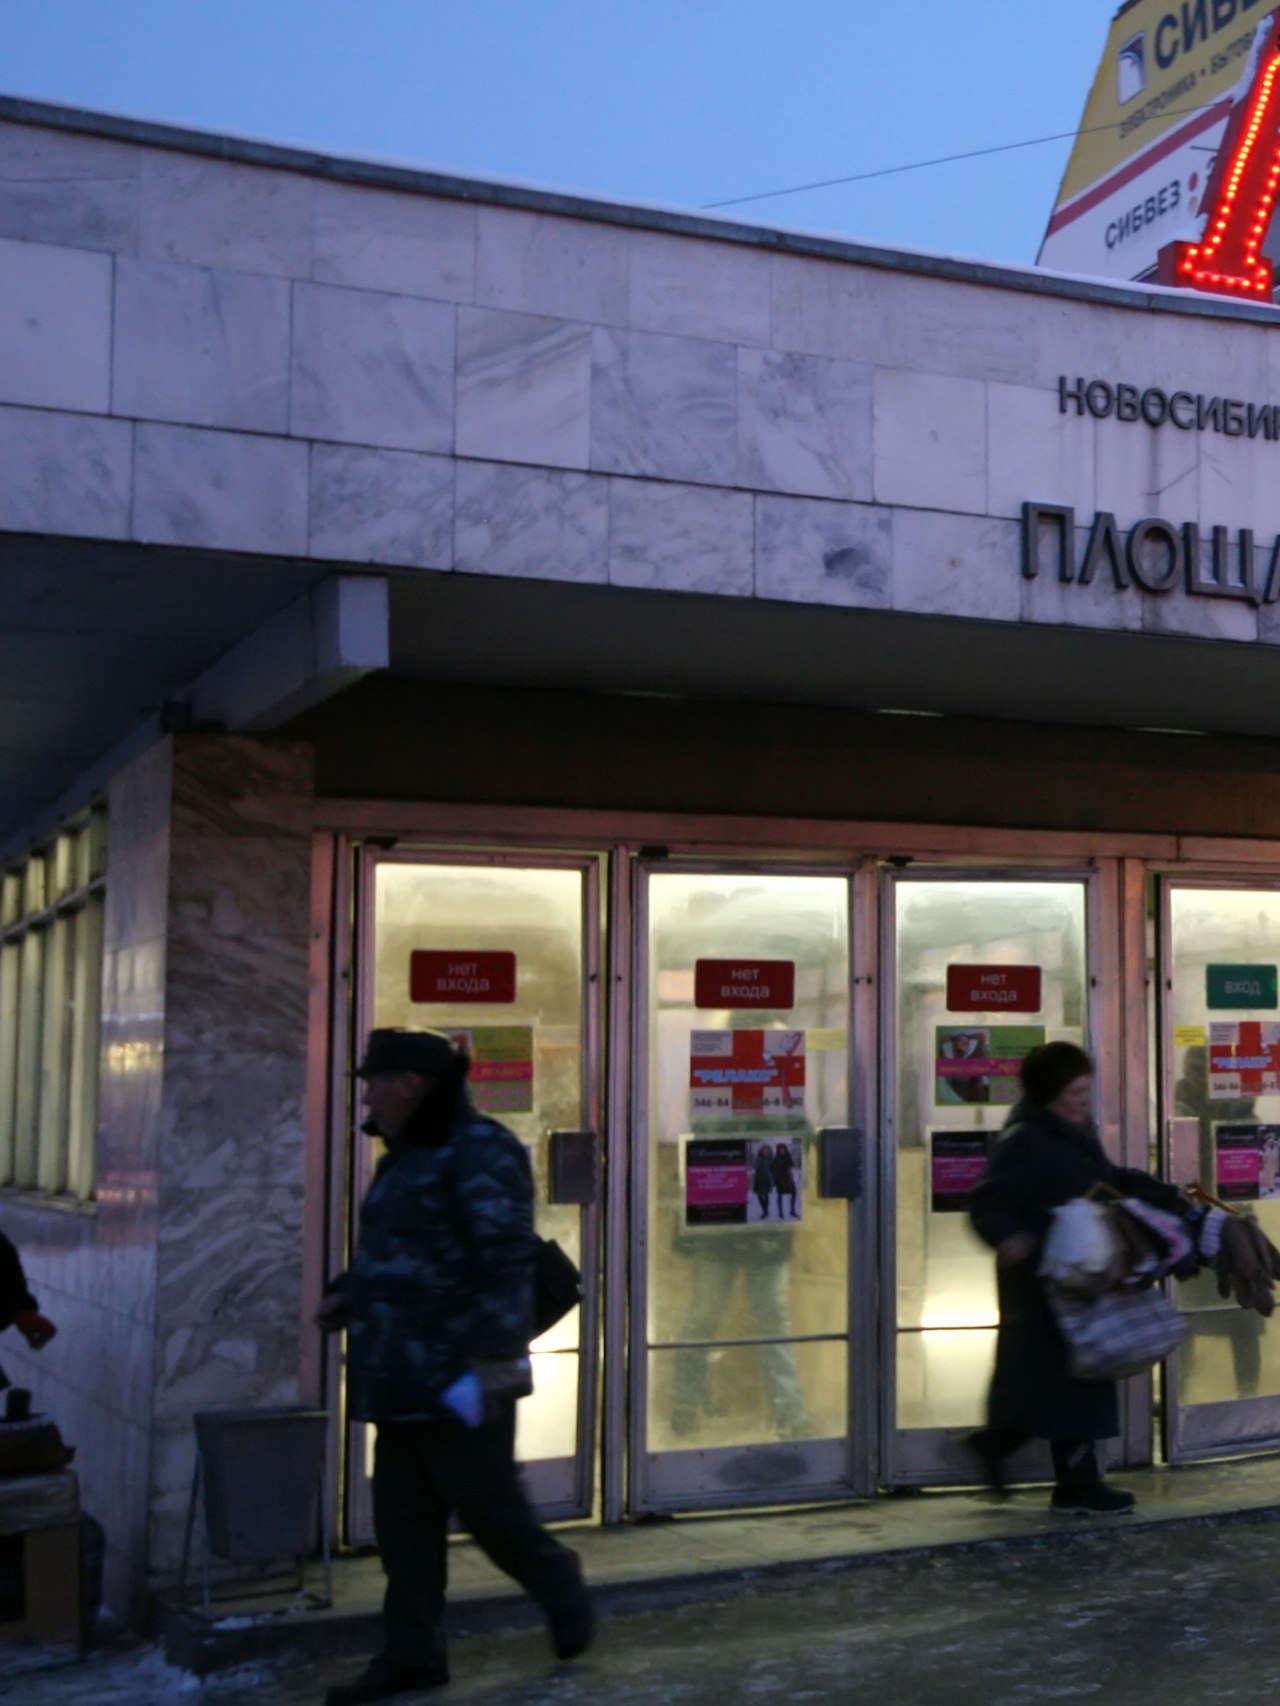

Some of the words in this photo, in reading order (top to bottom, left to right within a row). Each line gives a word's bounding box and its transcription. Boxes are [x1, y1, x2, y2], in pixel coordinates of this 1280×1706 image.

[1105, 179, 1181, 249] СИБВЕЗ
[447, 963, 479, 976] нет
[731, 968, 760, 980] нет
[436, 977, 491, 993] входа
[980, 973, 1009, 985] нет
[720, 985, 771, 999] входа
[1224, 980, 1262, 997] вход
[970, 989, 1018, 1003] входа
